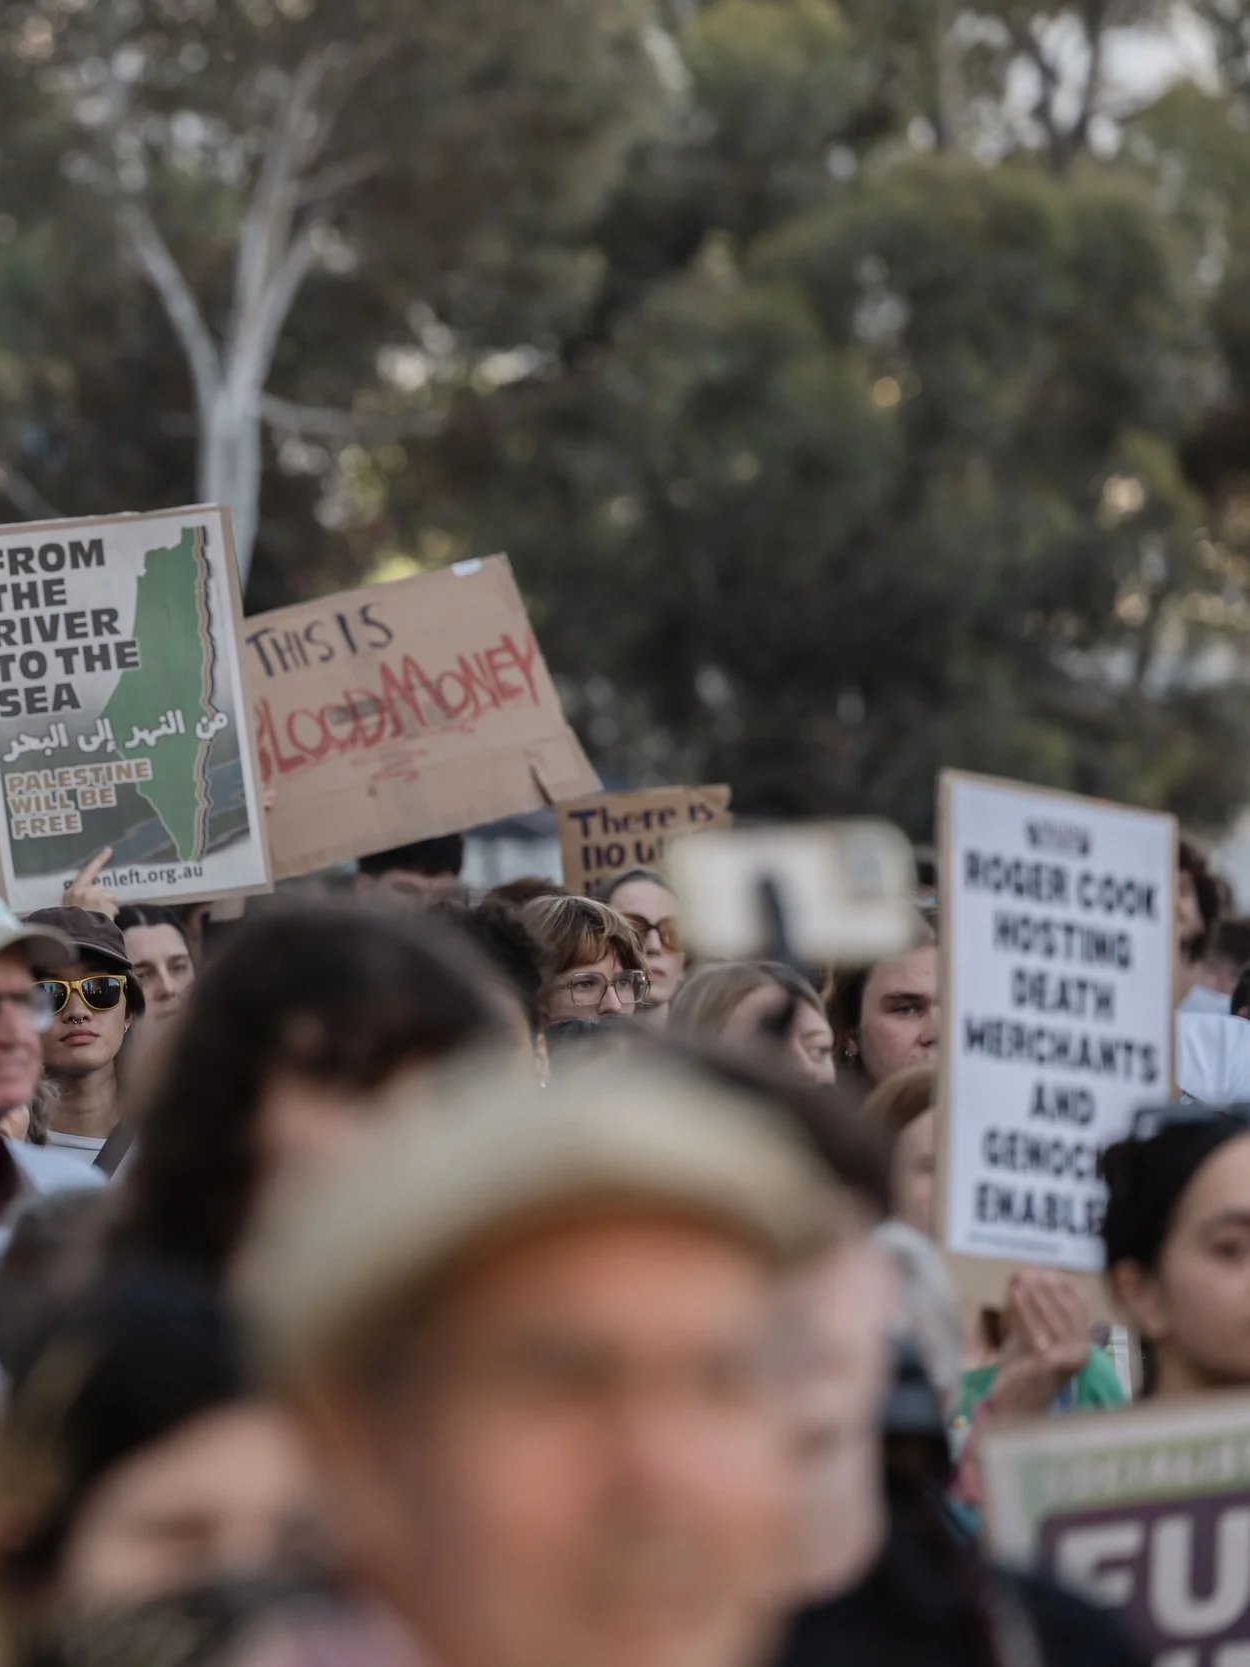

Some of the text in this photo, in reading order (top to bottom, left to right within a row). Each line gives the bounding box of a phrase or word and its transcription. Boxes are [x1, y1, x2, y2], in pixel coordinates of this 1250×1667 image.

[55, 640, 139, 676] THE
[246, 603, 394, 678] THIS IS
[379, 627, 539, 738] MONEY
[2, 722, 69, 763] البحر
[124, 708, 186, 749] النهر
[195, 711, 229, 740] من
[6, 759, 152, 795] PALESTINE
[9, 786, 116, 816] WILL BE
[567, 805, 677, 839] There
[12, 812, 81, 838] FREE
[581, 842, 626, 872] no
[965, 848, 1159, 920] ROGER COOK
[995, 911, 1131, 971] HOSTING
[1013, 966, 1116, 1022] DEATH
[964, 1013, 1158, 1084] MERCHANTS
[1029, 1079, 1096, 1126] AND
[981, 1127, 1106, 1181] GENOCI
[973, 1181, 1107, 1235] ENABLE
